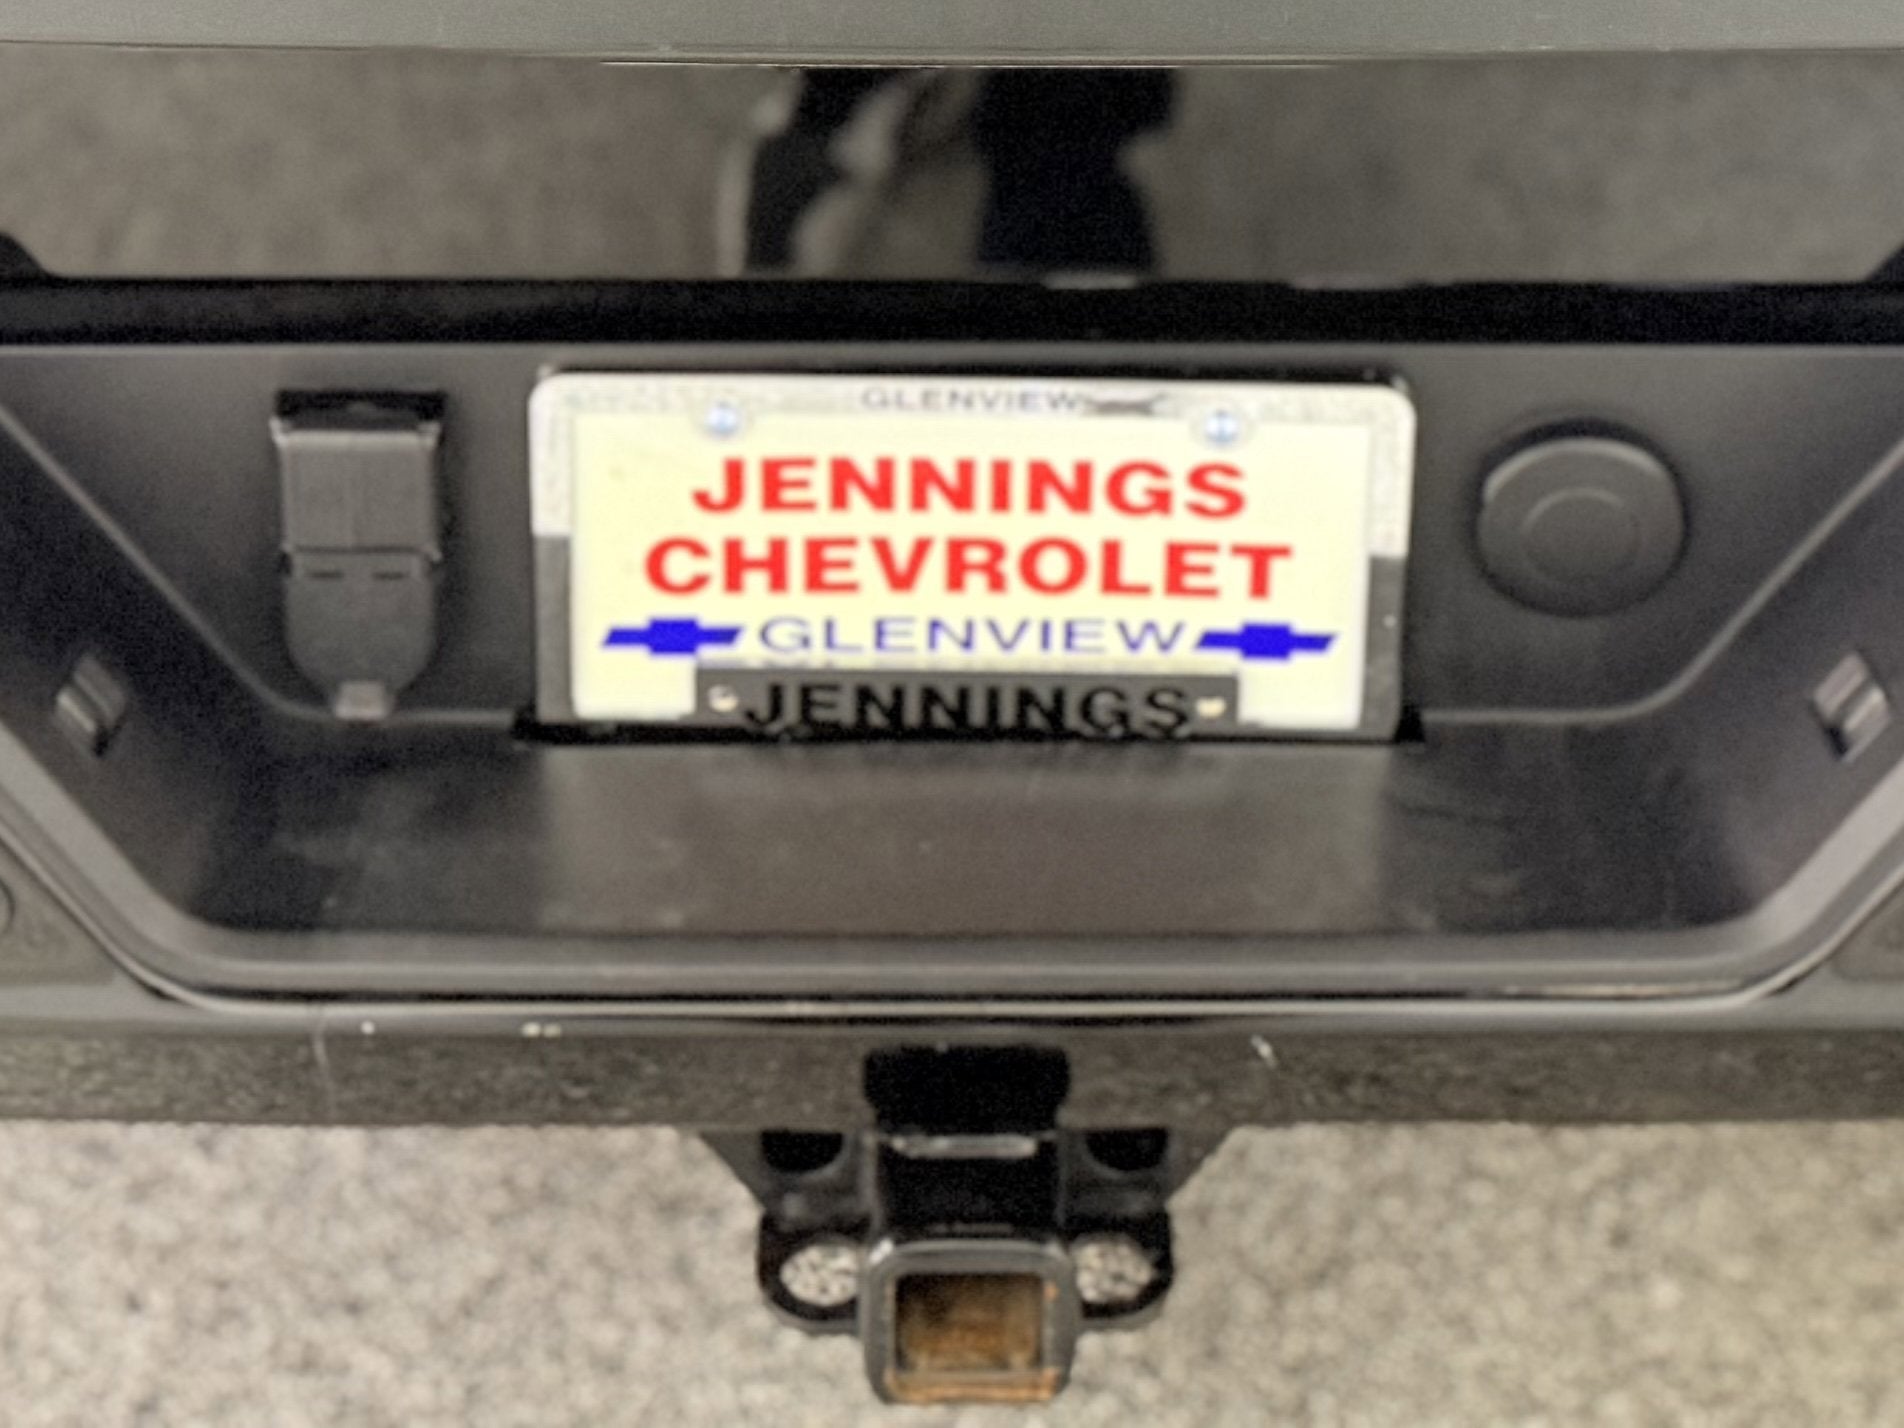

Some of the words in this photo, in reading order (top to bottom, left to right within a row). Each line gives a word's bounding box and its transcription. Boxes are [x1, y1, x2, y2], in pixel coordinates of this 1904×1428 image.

[861, 387, 1078, 410] GLENVIEW
[693, 456, 1247, 520] JENNINGS
[644, 536, 1292, 600] CHEVROLET
[760, 617, 1187, 654] GLENVIEW
[744, 682, 1192, 732] JENNINGS
